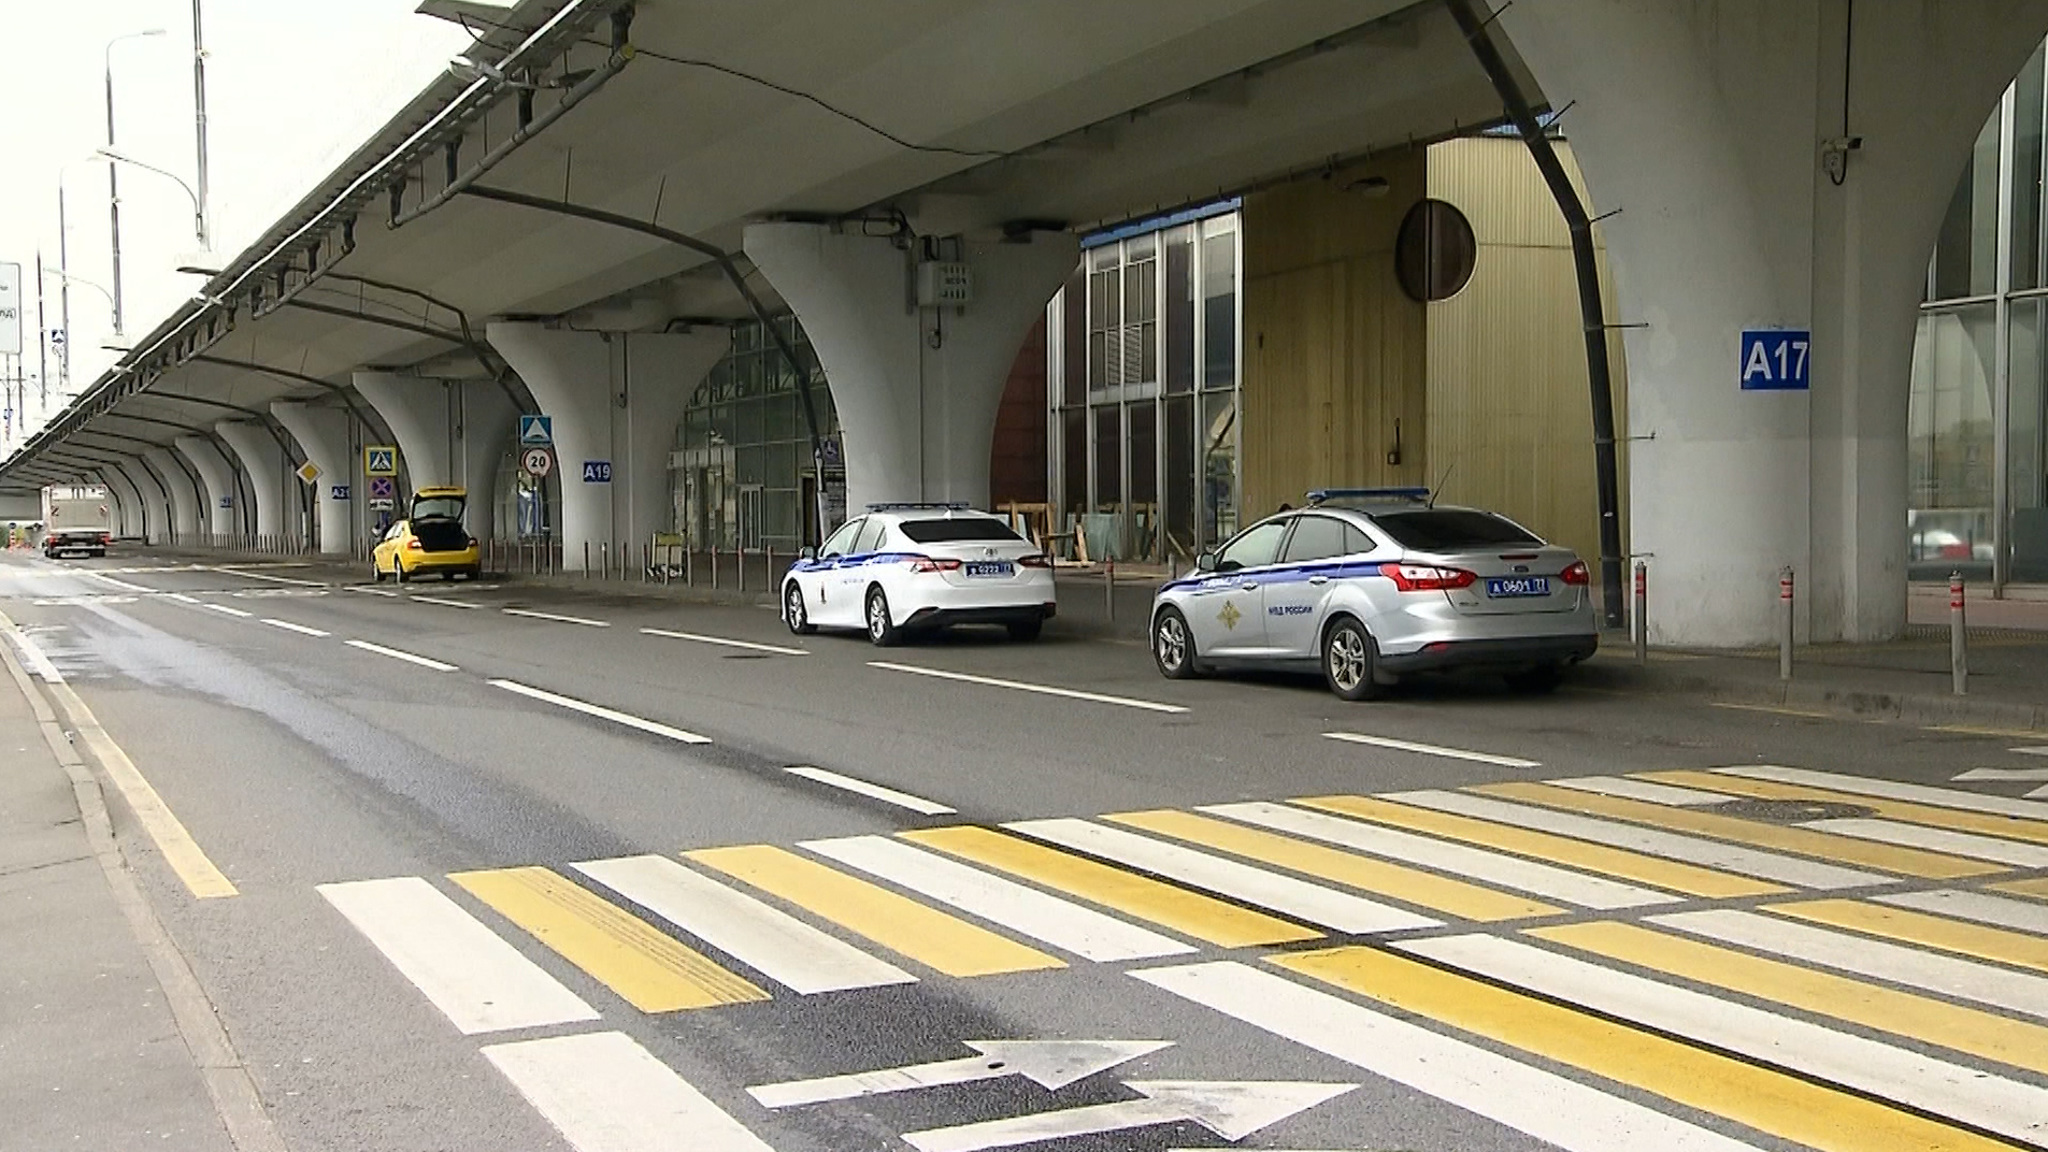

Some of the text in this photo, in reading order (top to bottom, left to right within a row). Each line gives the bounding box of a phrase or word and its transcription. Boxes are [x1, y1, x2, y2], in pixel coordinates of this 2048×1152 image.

[1743, 340, 1808, 381] A17
[531, 456, 546, 468] 20
[584, 464, 611, 479] A19
